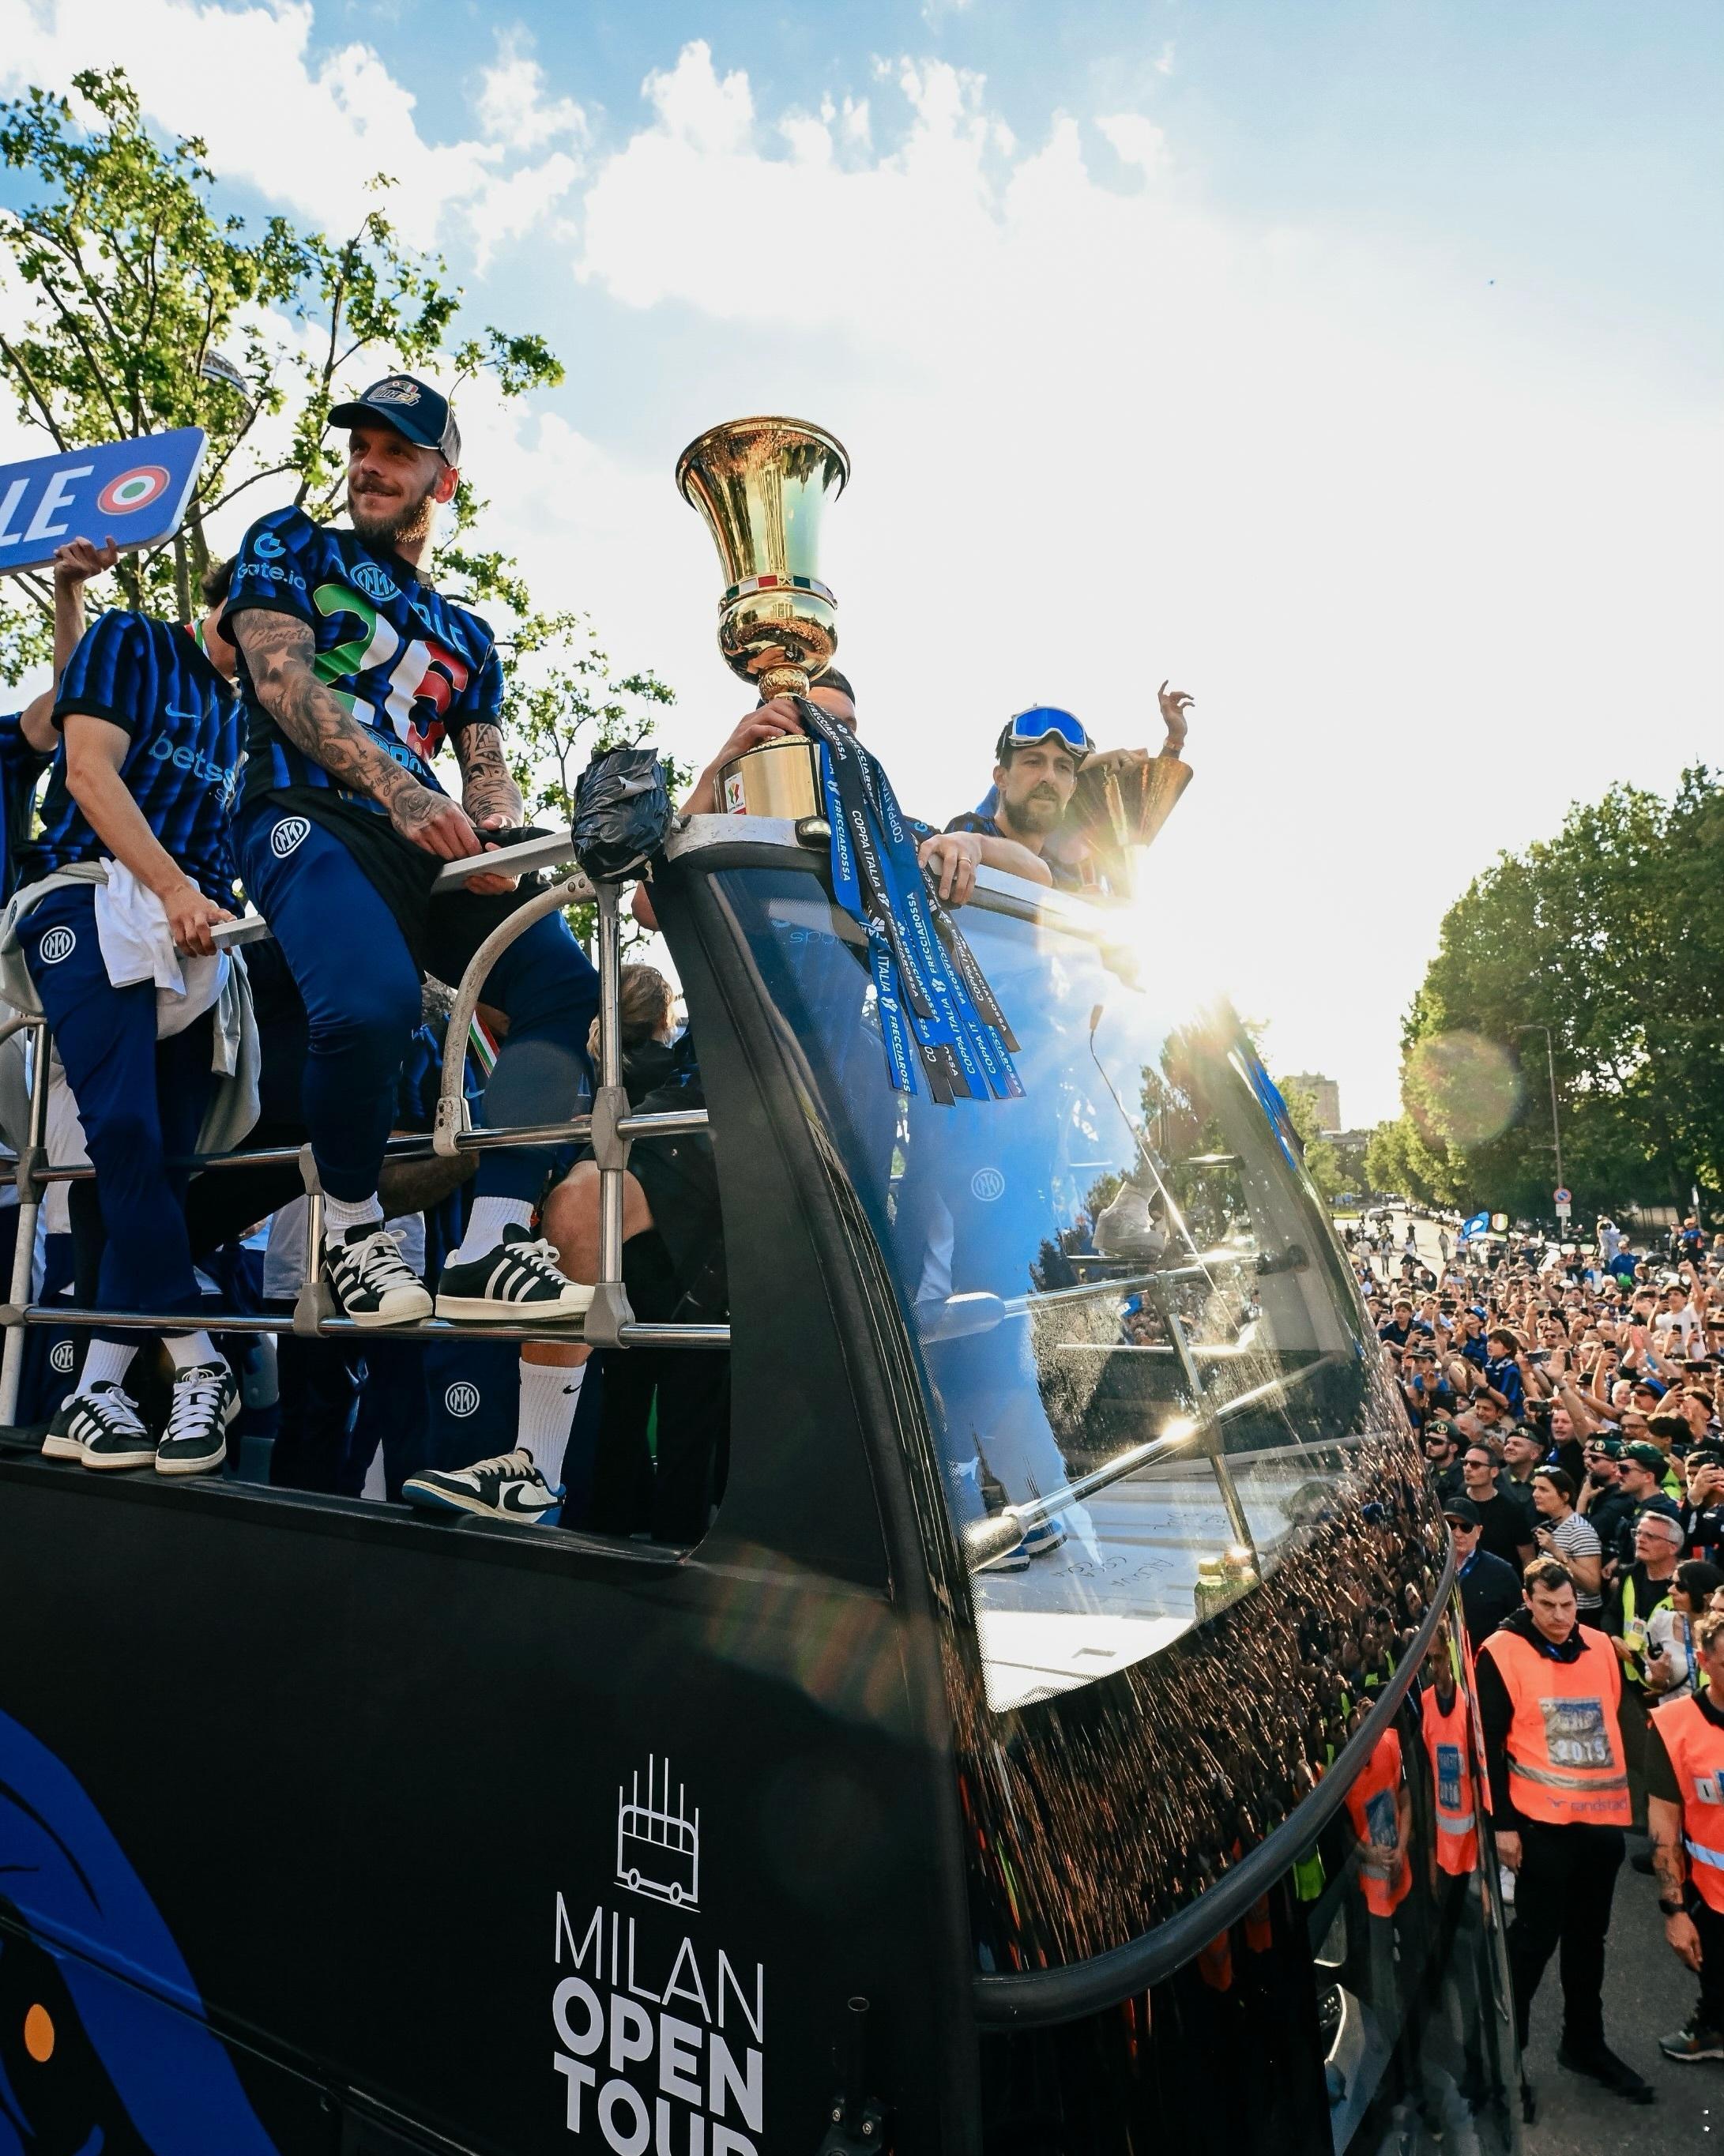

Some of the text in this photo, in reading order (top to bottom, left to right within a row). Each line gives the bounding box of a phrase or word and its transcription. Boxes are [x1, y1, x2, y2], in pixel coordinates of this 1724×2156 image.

[148, 729, 235, 792] betss
[807, 703, 847, 760] FRECCIAROSSA
[834, 799, 851, 882] FRECCIAROSSA
[852, 810, 881, 888] COPPA ITALIA
[886, 803, 904, 844] COPPA
[906, 892, 937, 974] FRECCIAROSSA
[877, 956, 891, 992] ITALIA
[941, 998, 961, 1033] ITALIA
[890, 1015, 911, 1093] FRECCIAROSS
[955, 1035, 976, 1074] COPPA
[975, 1035, 996, 1074] COPPA
[555, 1891, 763, 2043] MILAN
[553, 1977, 763, 2133] OPEN
